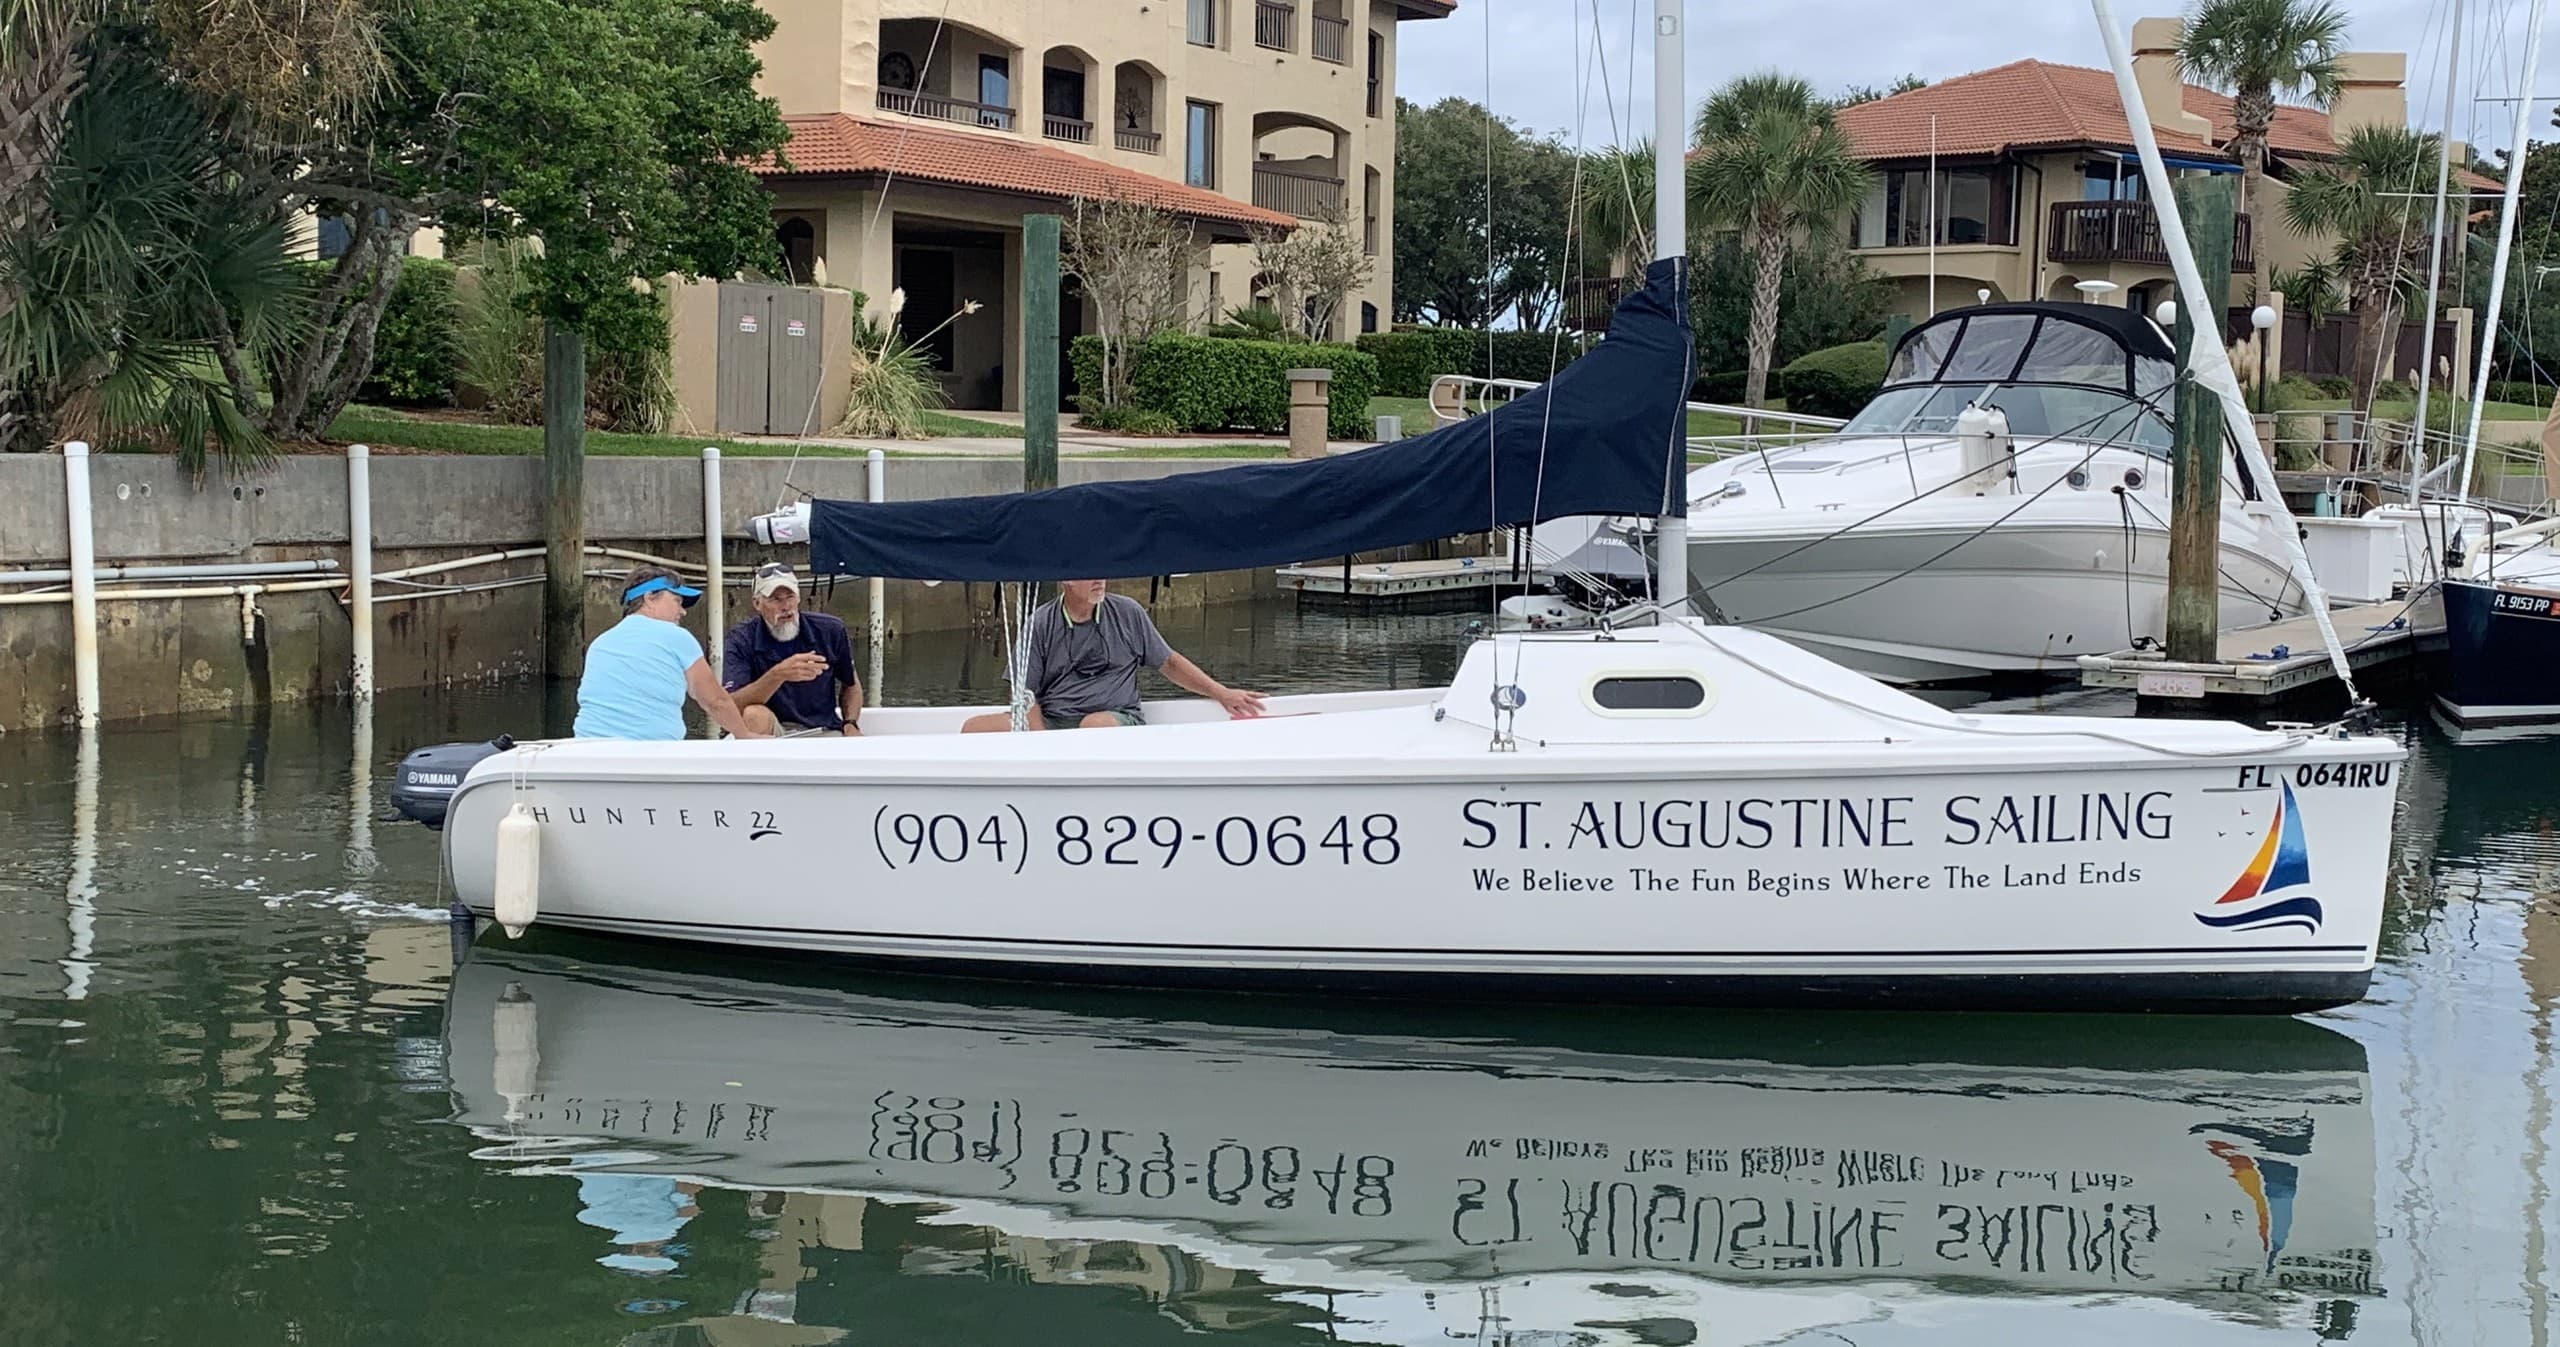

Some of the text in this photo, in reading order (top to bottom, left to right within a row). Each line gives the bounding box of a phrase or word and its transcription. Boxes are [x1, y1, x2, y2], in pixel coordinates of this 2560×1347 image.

[2494, 594, 2550, 612] FL 9153 PP
[418, 772, 458, 785] YAMAHA
[2237, 761, 2392, 789] FL 0641RU
[532, 806, 780, 831] HUNTER 22
[1462, 790, 2174, 850] ST. AUGUSTINE SAILING
[873, 802, 1402, 875] (904) 829-0648
[1472, 860, 2142, 898] We Believe The Fun Begins Where The Land Ends
